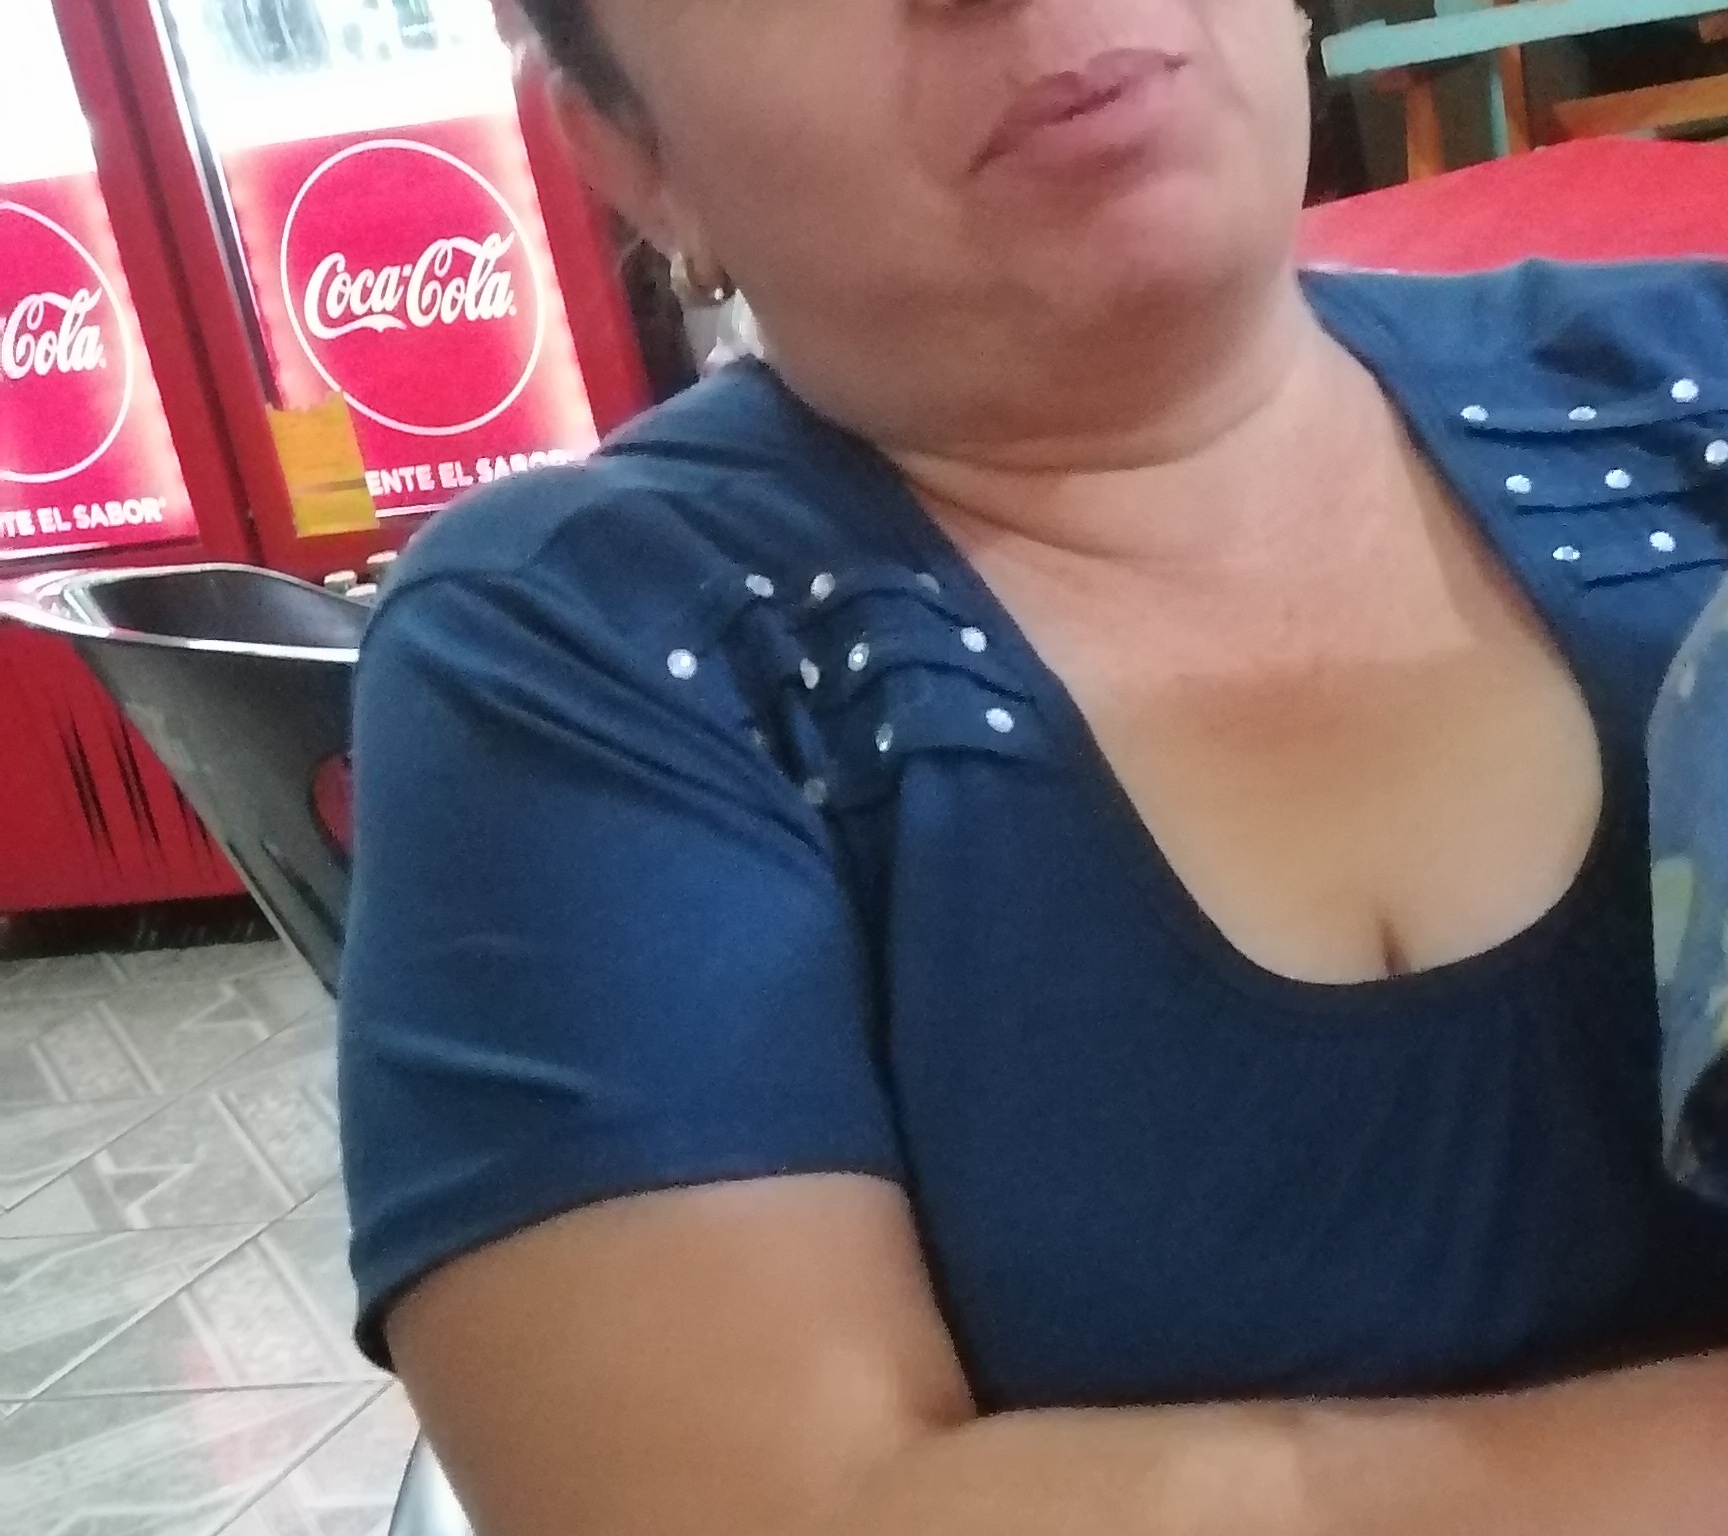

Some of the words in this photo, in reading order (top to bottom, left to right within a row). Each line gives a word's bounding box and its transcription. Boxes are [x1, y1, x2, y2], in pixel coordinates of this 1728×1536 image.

[304, 230, 518, 340] Coca-Cola
[365, 464, 435, 497] ENTE
[438, 460, 474, 489] EL
[37, 506, 72, 534] EL
[73, 497, 164, 529] SABOR
